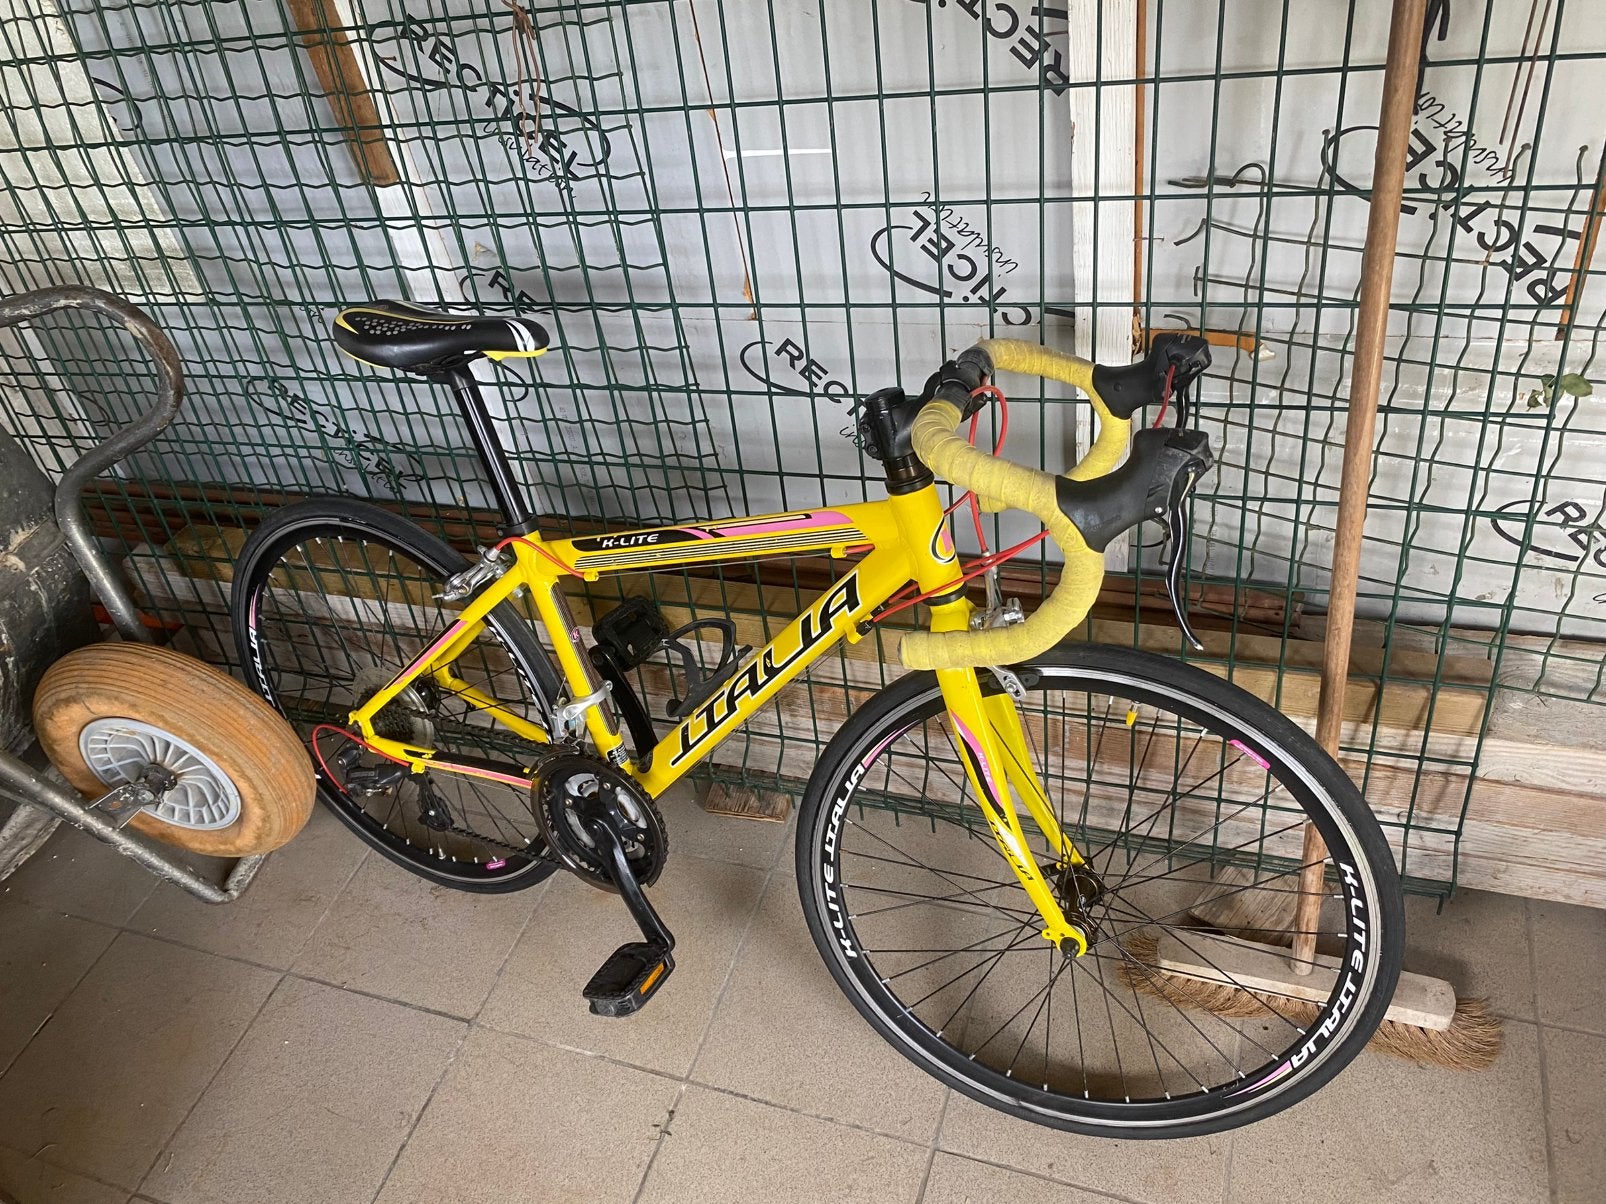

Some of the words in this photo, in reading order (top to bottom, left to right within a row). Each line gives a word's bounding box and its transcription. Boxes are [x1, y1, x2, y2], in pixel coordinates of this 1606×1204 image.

[1405, 127, 1570, 305] RECTICE
[601, 533, 659, 548] K-LITE
[671, 570, 863, 767] ITALIA
[824, 763, 866, 862] ITALIA
[823, 862, 858, 958] K-LITE
[1338, 861, 1366, 974] K-LITE
[1290, 971, 1357, 1069] ITALIA
